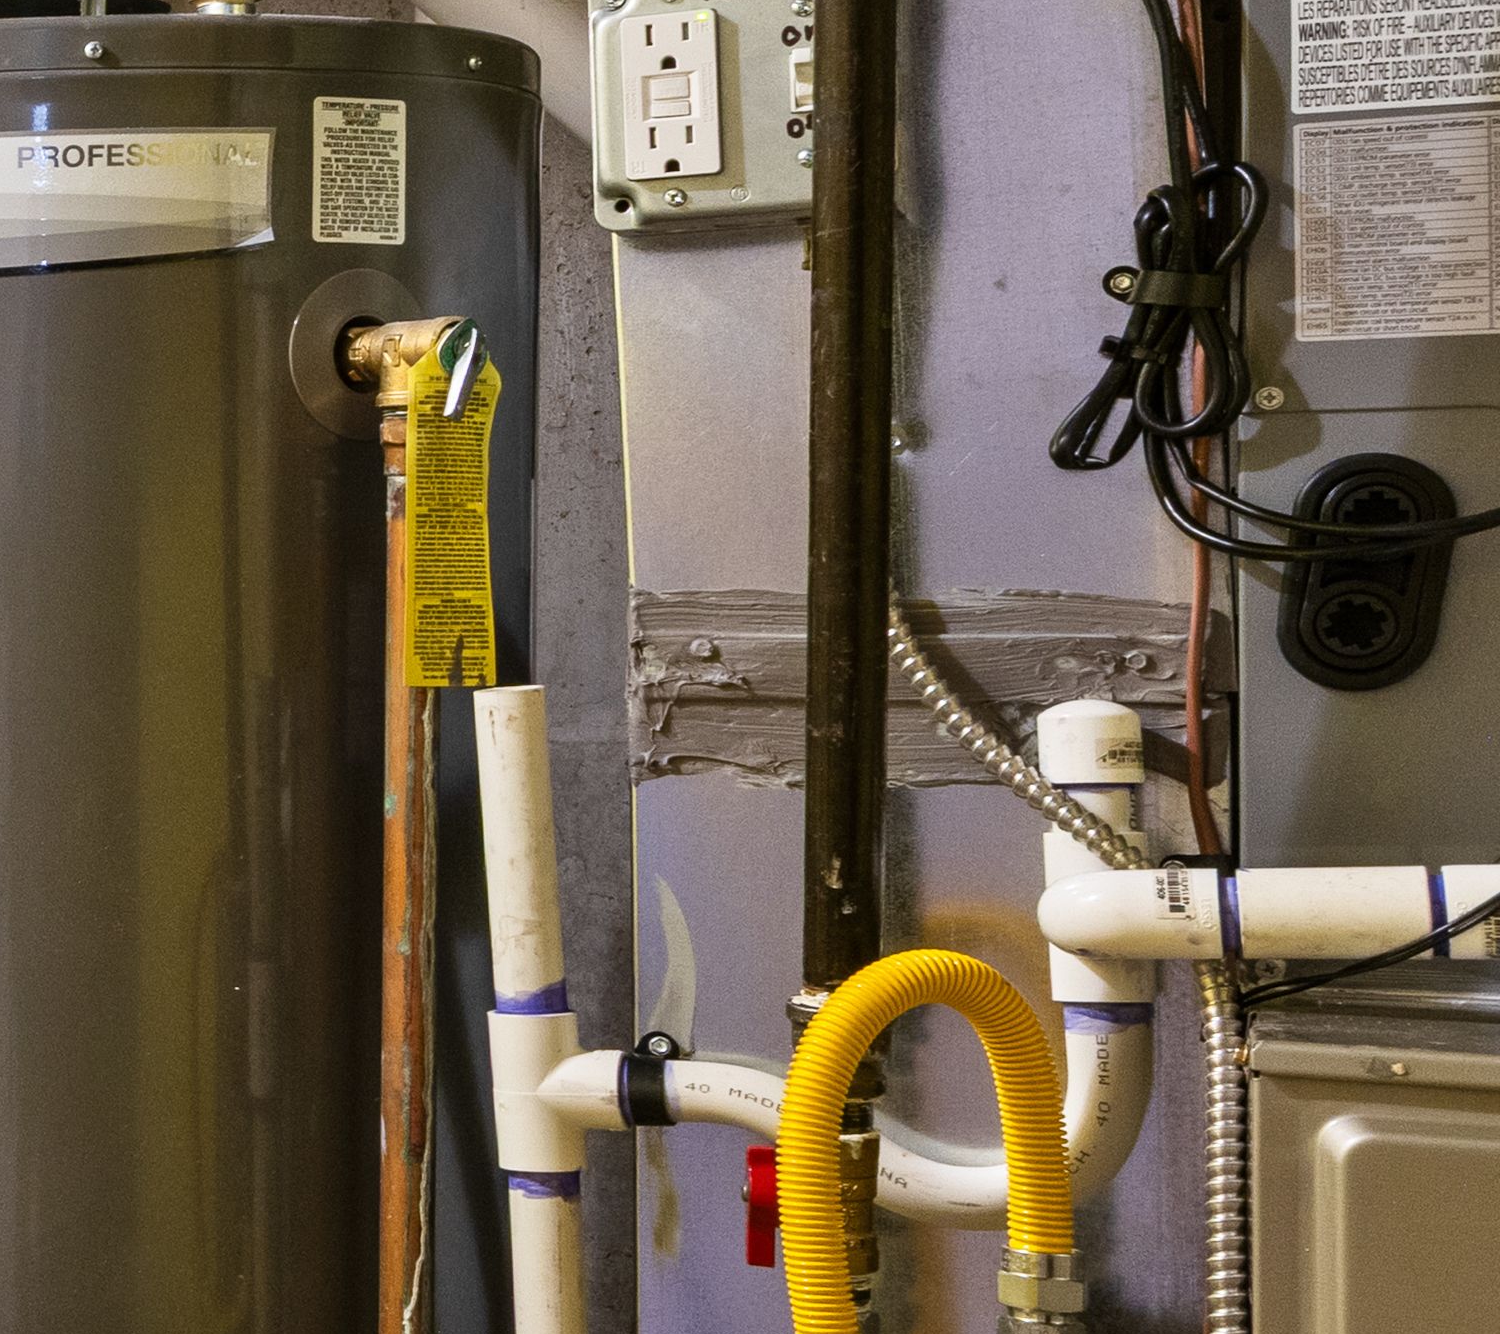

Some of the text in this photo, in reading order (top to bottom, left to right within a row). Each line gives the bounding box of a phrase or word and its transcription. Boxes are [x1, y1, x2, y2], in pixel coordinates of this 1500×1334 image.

[1299, 20, 1350, 42] WARNING:
[1303, 119, 1484, 139] Display Malfunction protection indication
[17, 142, 262, 170] PROFESSIONAL
[1096, 1034, 1110, 1086] MADE
[685, 1083, 711, 1094] 40
